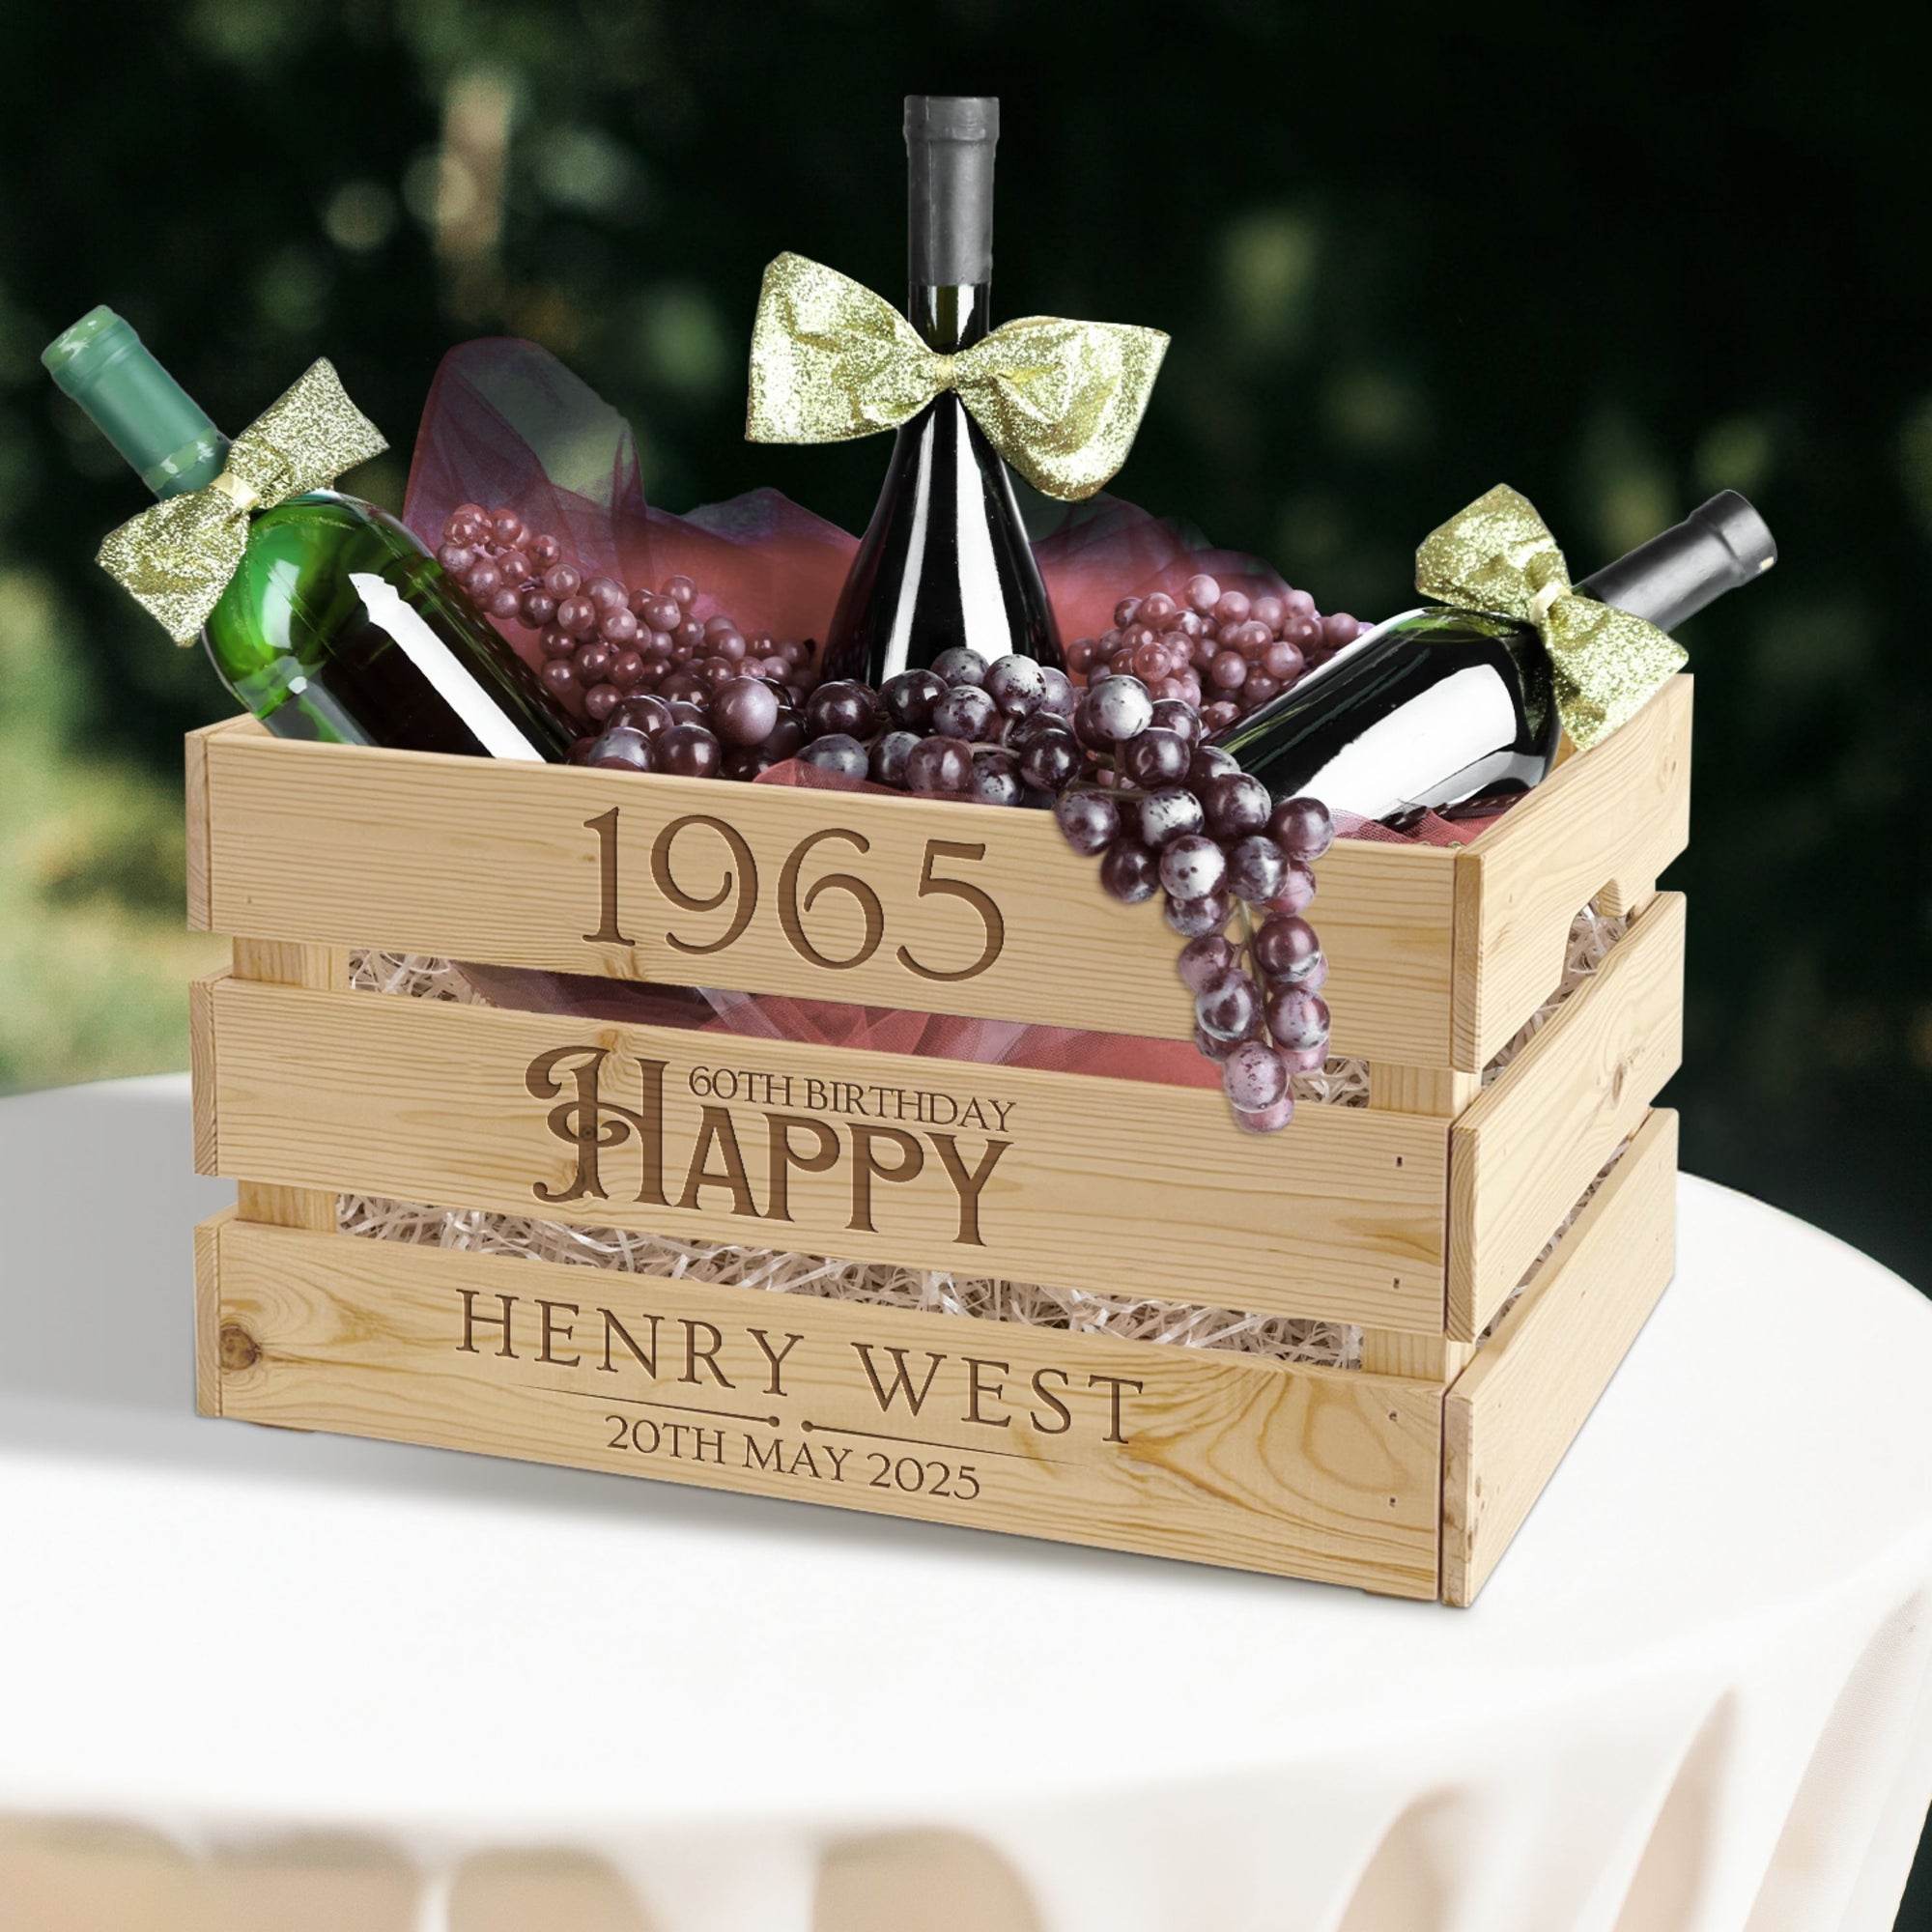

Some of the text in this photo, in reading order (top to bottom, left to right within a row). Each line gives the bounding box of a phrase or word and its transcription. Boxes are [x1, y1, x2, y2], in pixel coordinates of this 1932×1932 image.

[582, 807, 1005, 981] 1965
[524, 1045, 1014, 1247] HAPPY
[689, 1065, 1016, 1133] 60TH BIRTHDAY
[455, 1289, 1144, 1444] HENRY WEST
[605, 1413, 980, 1501] 20TH MAY 2025
